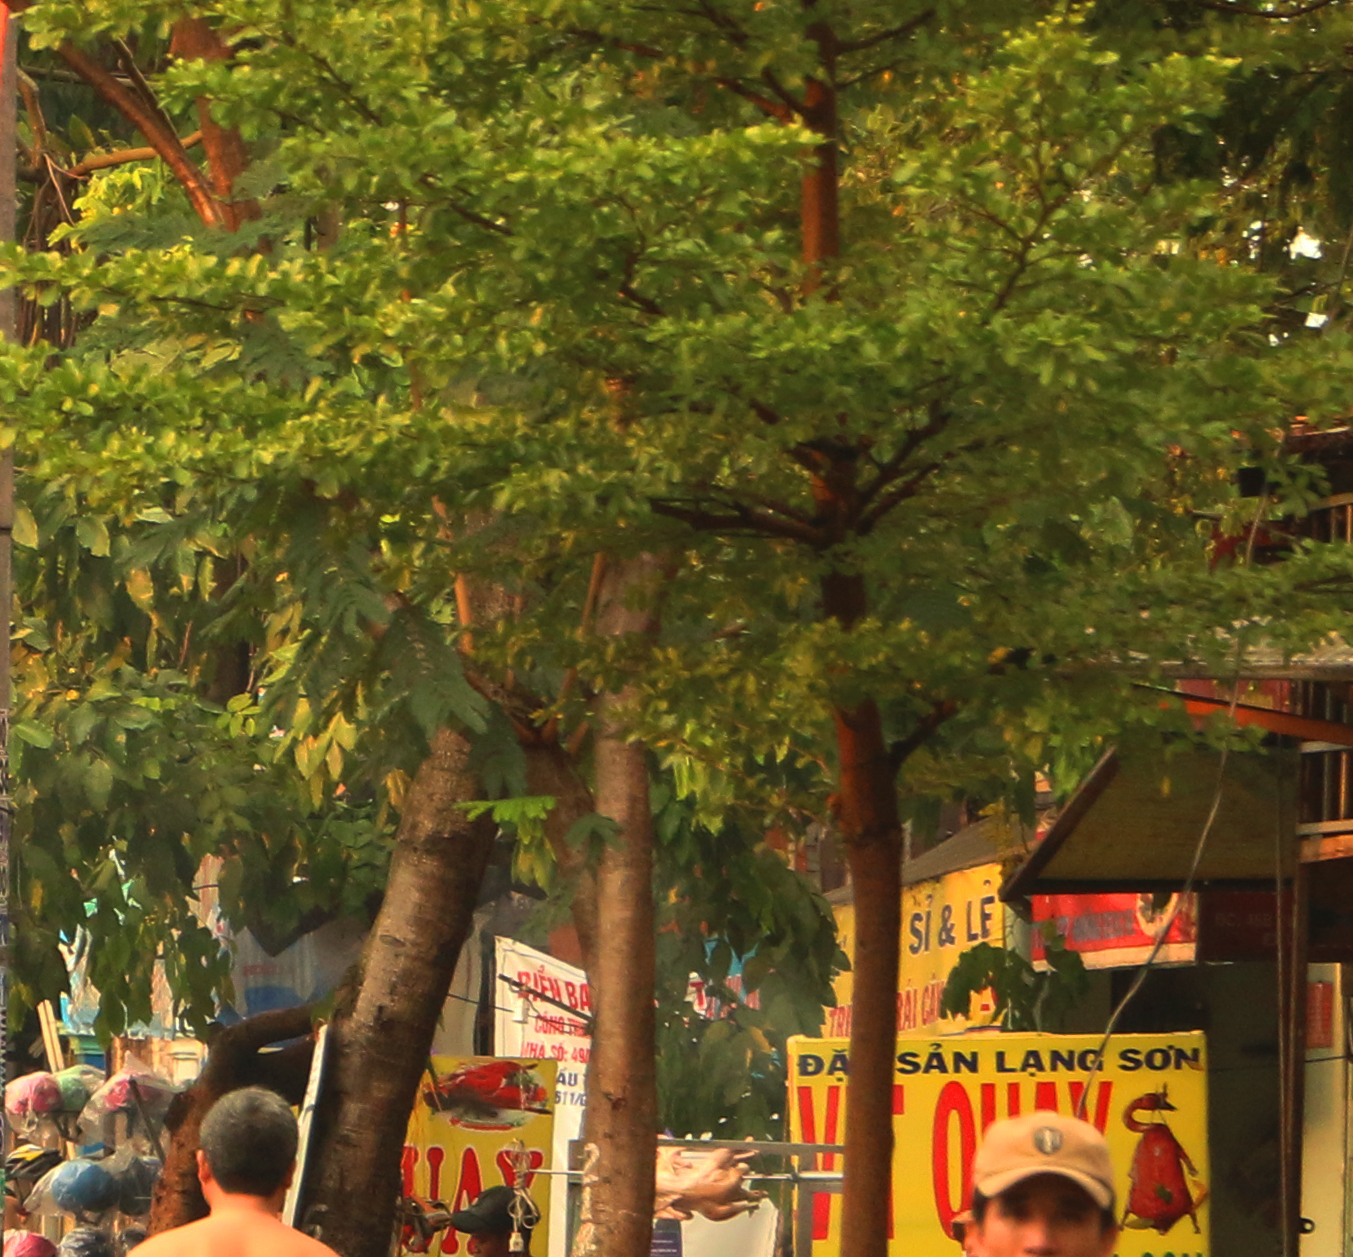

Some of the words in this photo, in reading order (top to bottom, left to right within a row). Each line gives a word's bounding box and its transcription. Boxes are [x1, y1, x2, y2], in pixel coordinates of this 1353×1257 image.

[938, 904, 956, 947] &
[896, 1043, 979, 1074] SẢN
[996, 1049, 1104, 1077] LẠNG
[1118, 1045, 1201, 1072] SƠN
